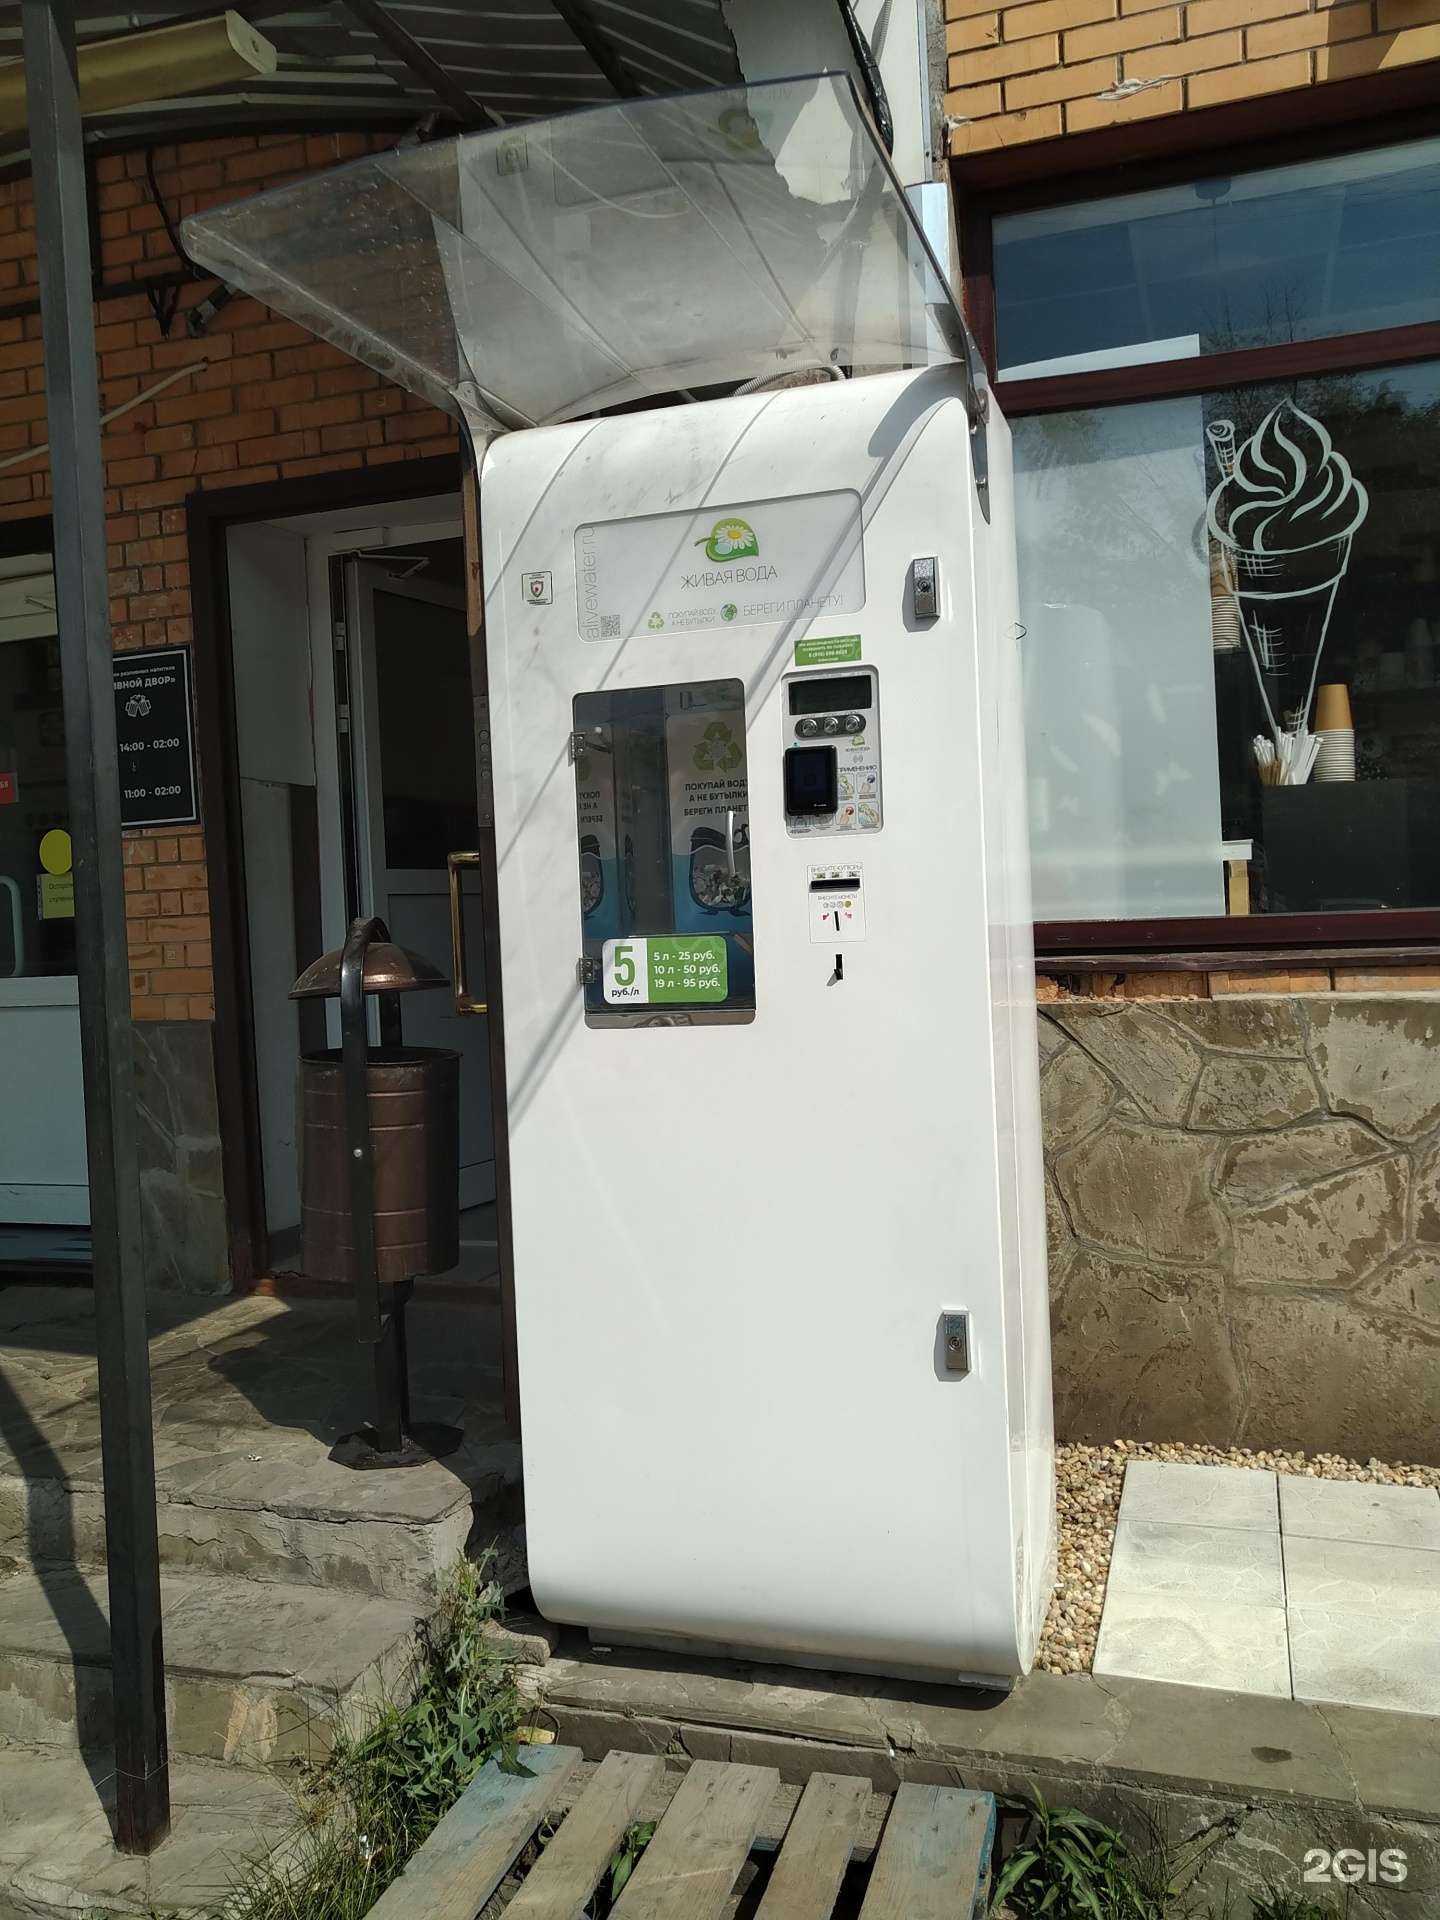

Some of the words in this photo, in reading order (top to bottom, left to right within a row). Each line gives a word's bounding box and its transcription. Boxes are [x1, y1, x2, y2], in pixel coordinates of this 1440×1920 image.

[582, 526, 600, 639] alivewater.ru
[680, 570, 733, 590] ЖИВАЯ
[736, 565, 778, 583] ВОДА
[743, 602, 786, 617] БЕРЕГИ
[788, 594, 844, 611] ПЛАНЕТУ!
[145, 675, 176, 687] ДВОР»
[120, 741, 144, 752] 14:00
[153, 738, 180, 749] 02:00
[685, 779, 725, 791] ПОКУПАЙ
[124, 788, 146, 799] 11:00
[154, 785, 181, 796] 02:00
[710, 791, 748, 800] БУТЫЛКИ
[684, 807, 713, 816] БЕРЕГИ
[653, 952, 660, 961] 5
[678, 952, 691, 960] 25
[693, 951, 715, 963] руб.
[614, 945, 636, 986] 5
[654, 966, 665, 974] 10
[683, 965, 696, 974] 50
[699, 964, 721, 976] руб.
[654, 979, 665, 988] 19
[667, 980, 674, 988] л
[683, 979, 696, 987] 95
[698, 978, 721, 990] руб.
[611, 986, 639, 997] руб./л
